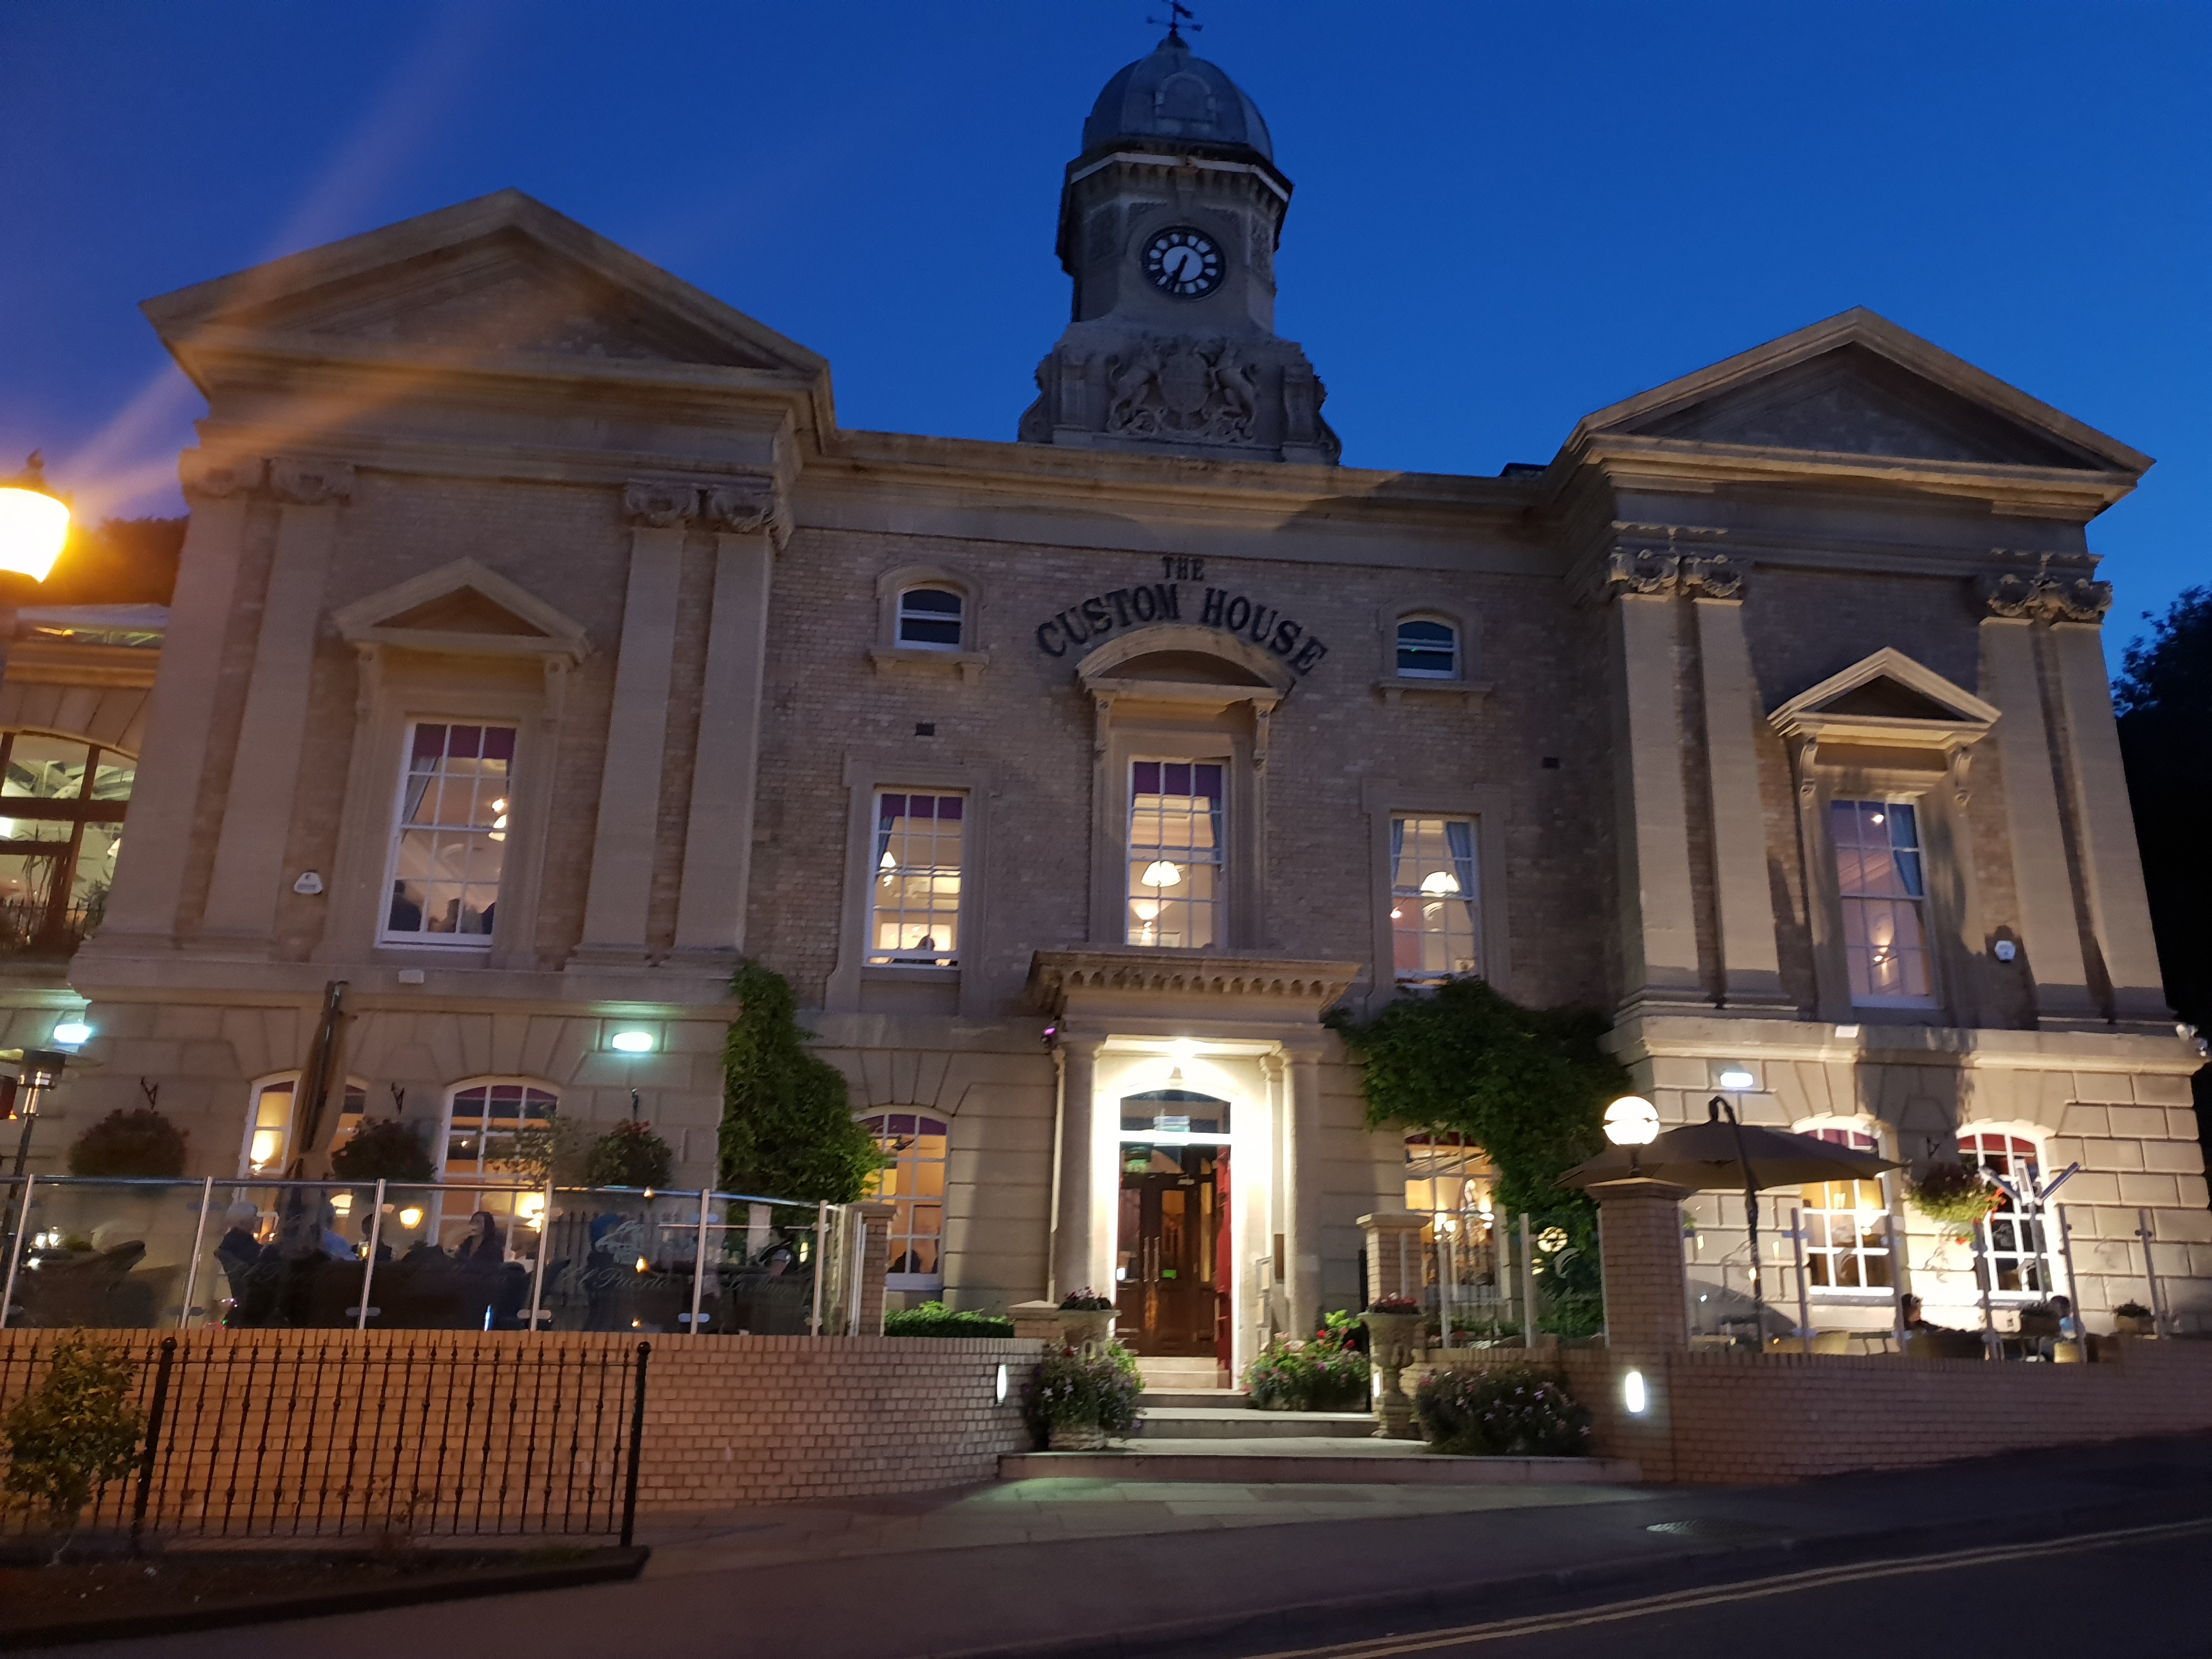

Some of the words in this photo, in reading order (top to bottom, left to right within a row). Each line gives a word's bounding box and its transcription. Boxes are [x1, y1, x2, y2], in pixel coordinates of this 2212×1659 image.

[1161, 555, 1205, 582] THE
[1036, 583, 1182, 658] CUSTOM
[1199, 586, 1328, 676] HOUSE
